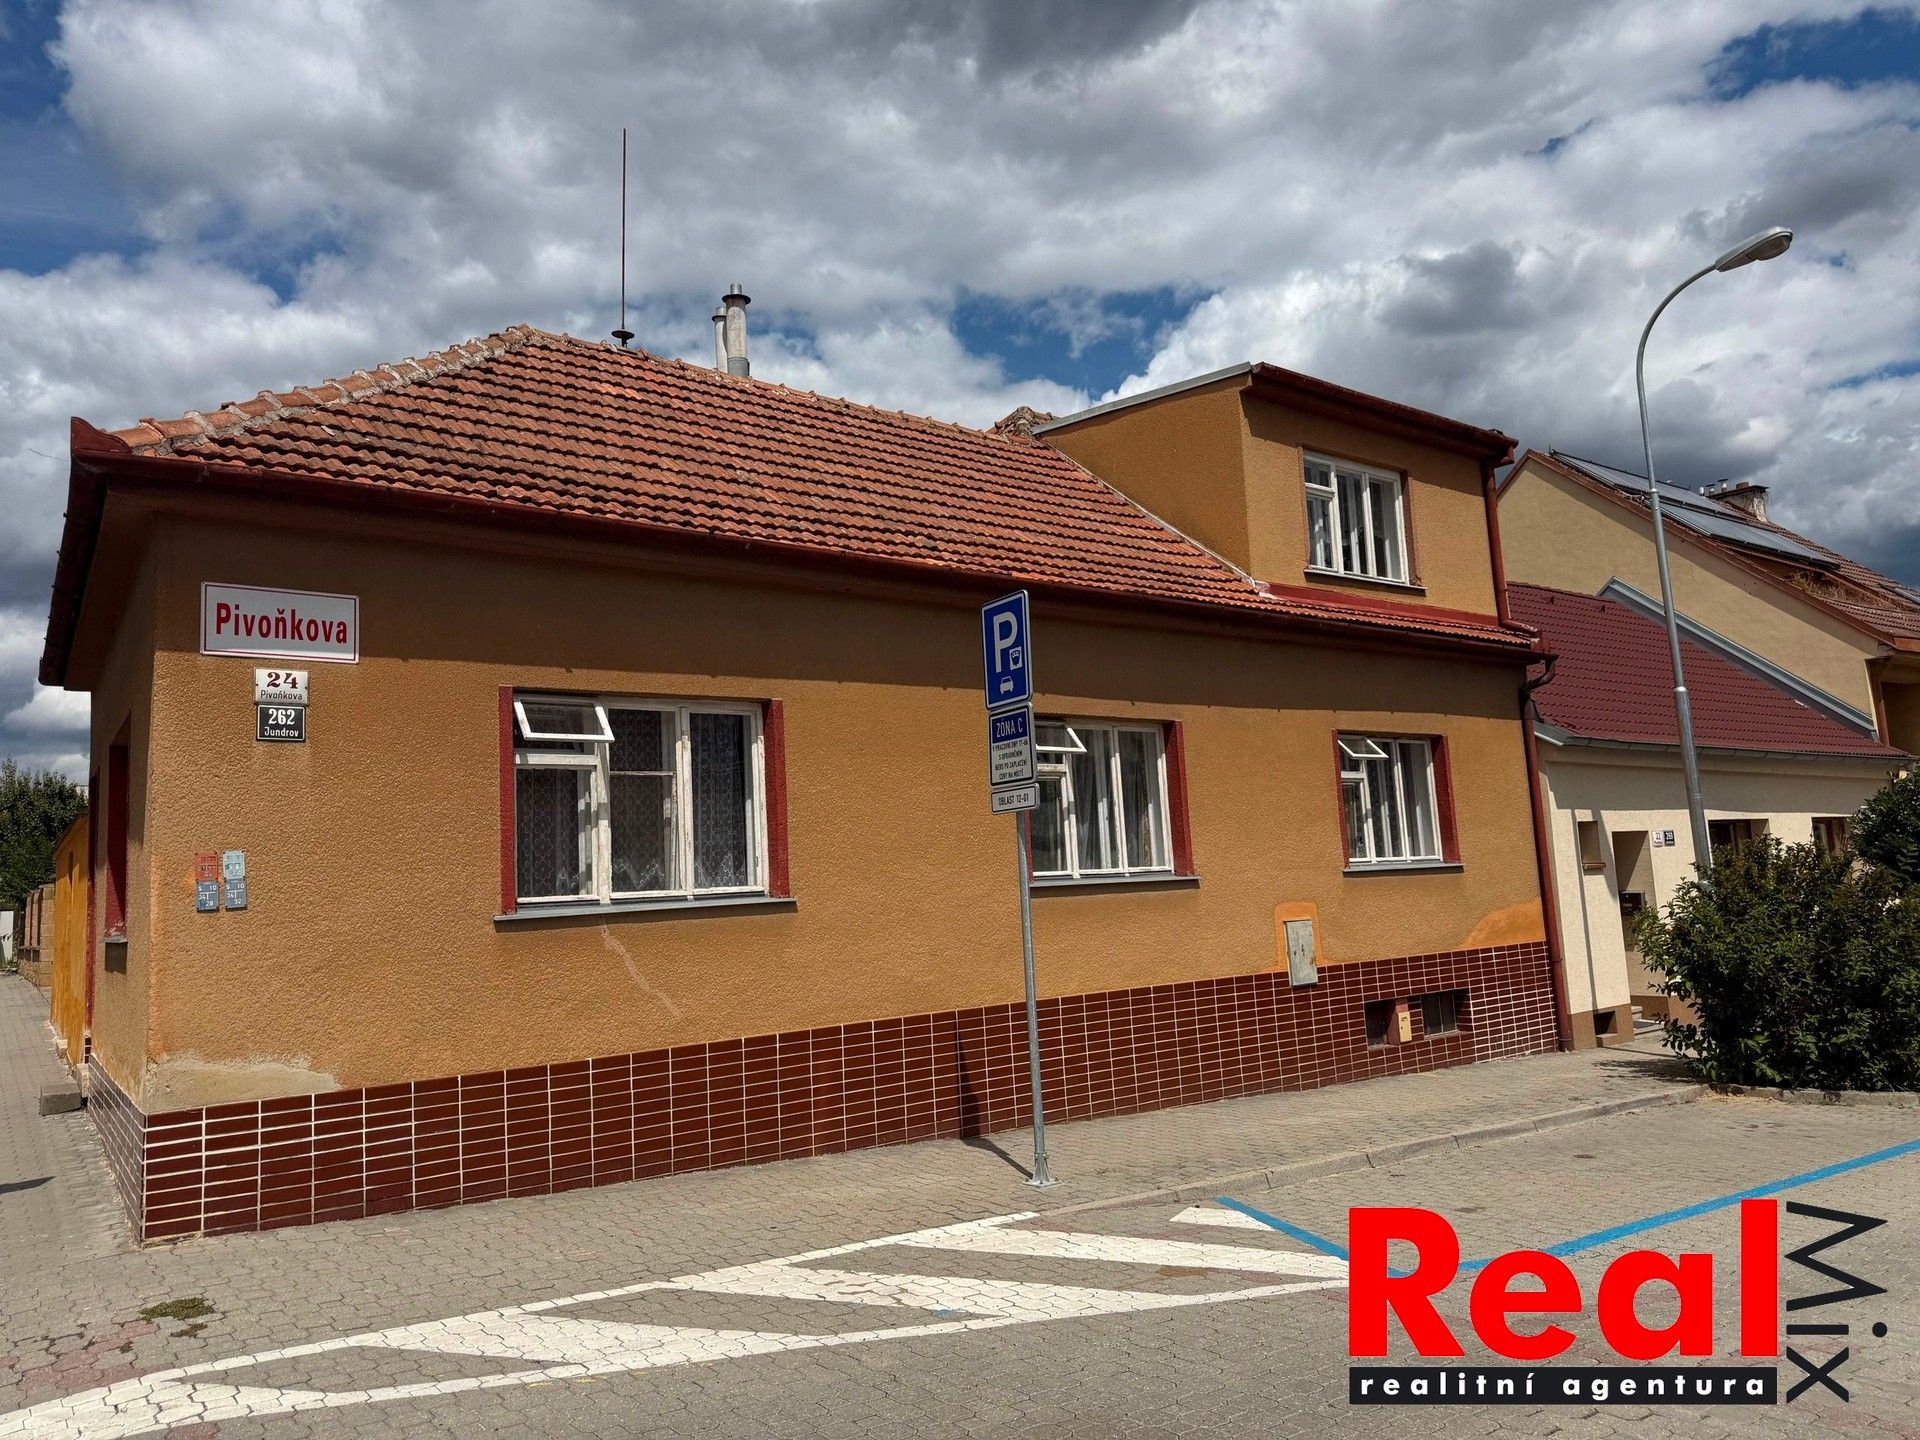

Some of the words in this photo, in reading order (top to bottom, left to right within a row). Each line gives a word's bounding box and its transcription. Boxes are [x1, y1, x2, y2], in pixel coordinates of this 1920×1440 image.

[216, 602, 348, 644] Pivoňkova
[993, 611, 1018, 673] P
[266, 671, 299, 689] 24
[260, 689, 303, 701] Pivoňkova
[268, 708, 296, 725] 262
[264, 726, 299, 738] Jundrov
[996, 718, 1016, 738] ZÓNA
[1017, 717, 1023, 733] C
[998, 794, 1015, 806] OBLAST
[1016, 793, 1029, 803] 12-01
